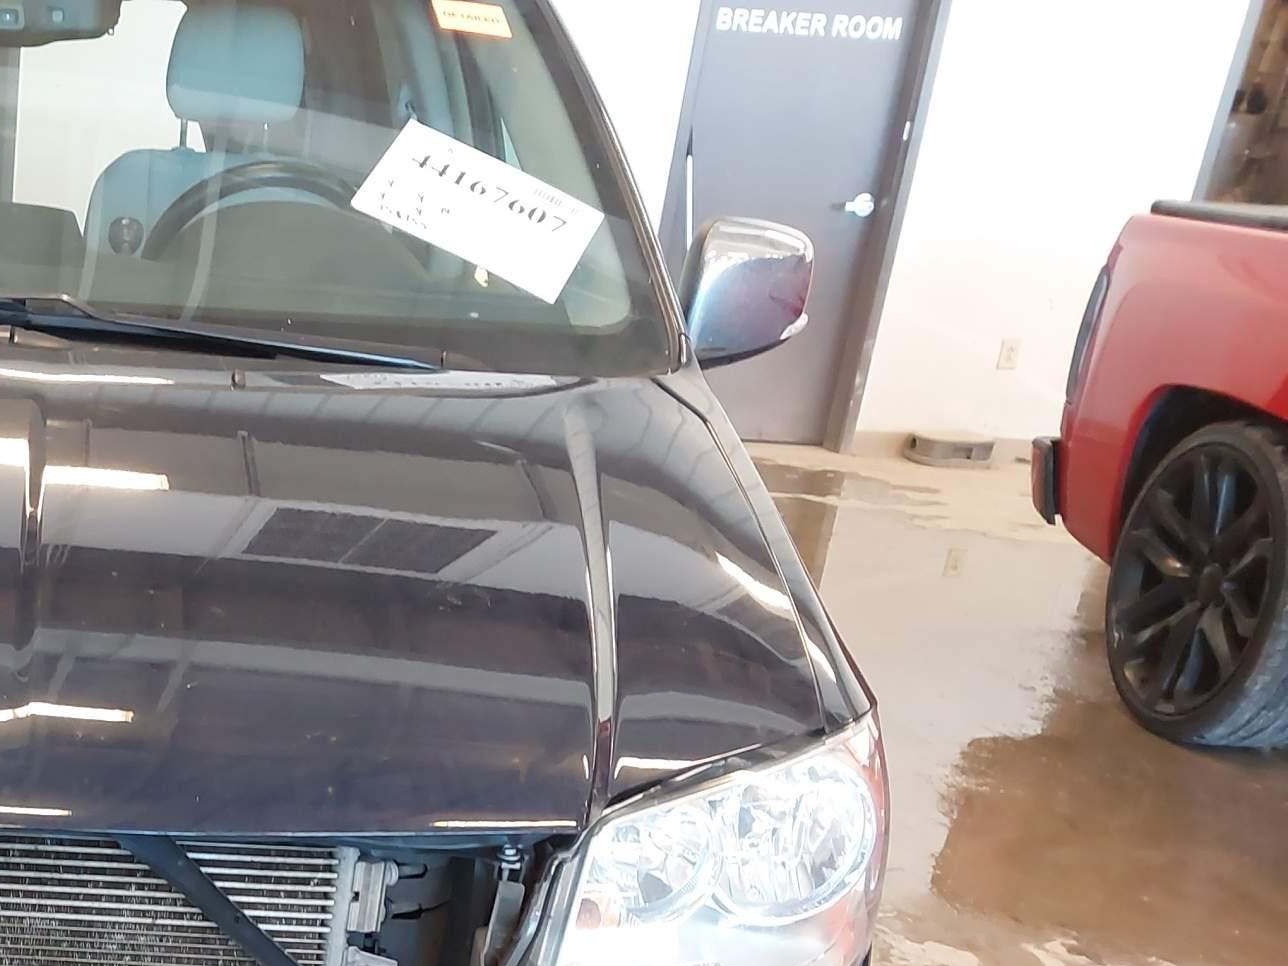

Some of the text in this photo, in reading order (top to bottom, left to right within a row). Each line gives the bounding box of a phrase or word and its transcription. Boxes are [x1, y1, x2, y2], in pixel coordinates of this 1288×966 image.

[716, 7, 903, 40] BREAKER ROOM
[411, 155, 568, 232] 44167607
